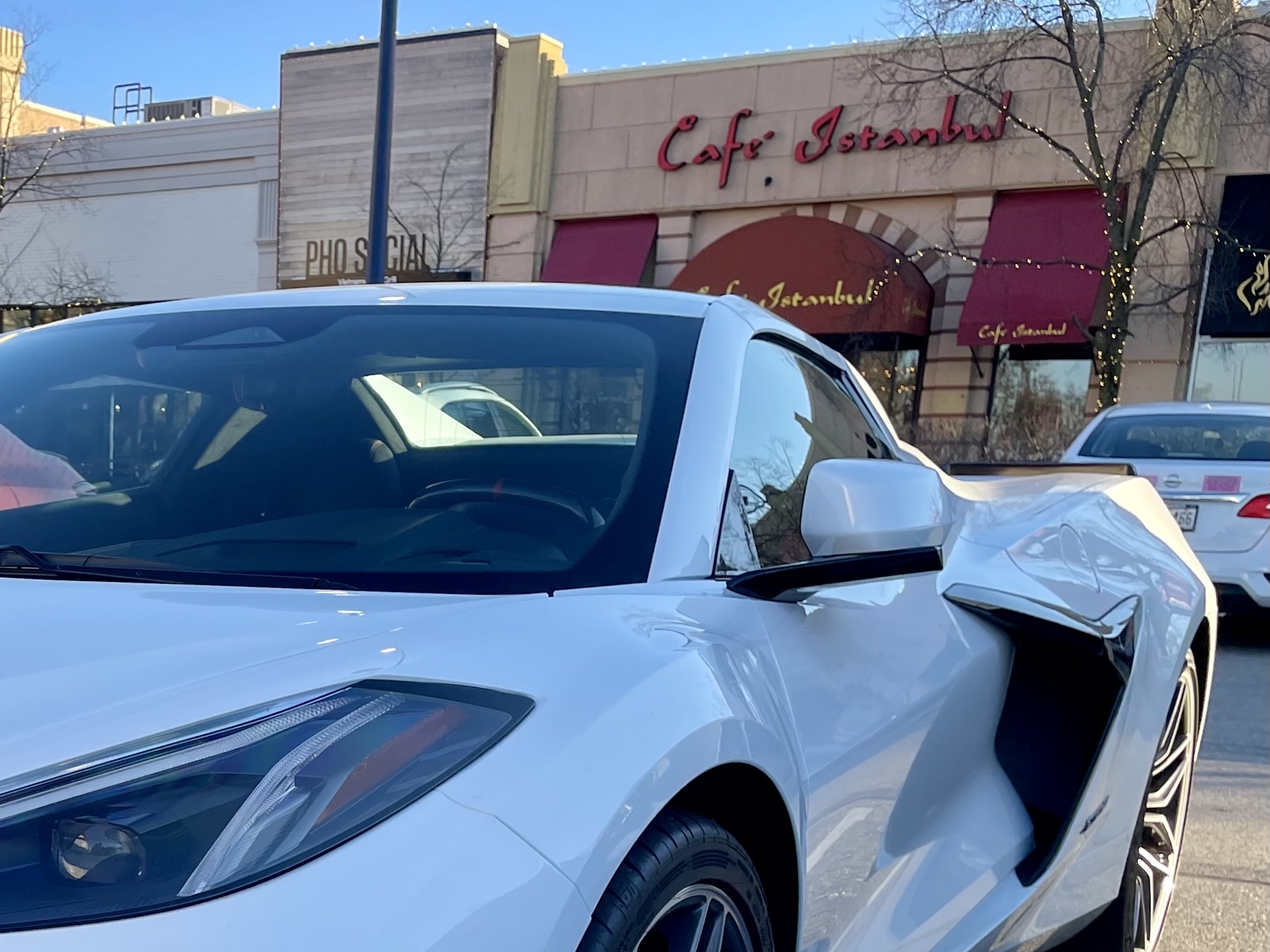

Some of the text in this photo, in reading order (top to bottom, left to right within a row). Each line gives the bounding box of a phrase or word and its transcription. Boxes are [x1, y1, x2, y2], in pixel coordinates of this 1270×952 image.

[794, 90, 1012, 164] Istanbul
[306, 233, 430, 276] PHO SCIAL
[758, 278, 875, 309] Istanbul
